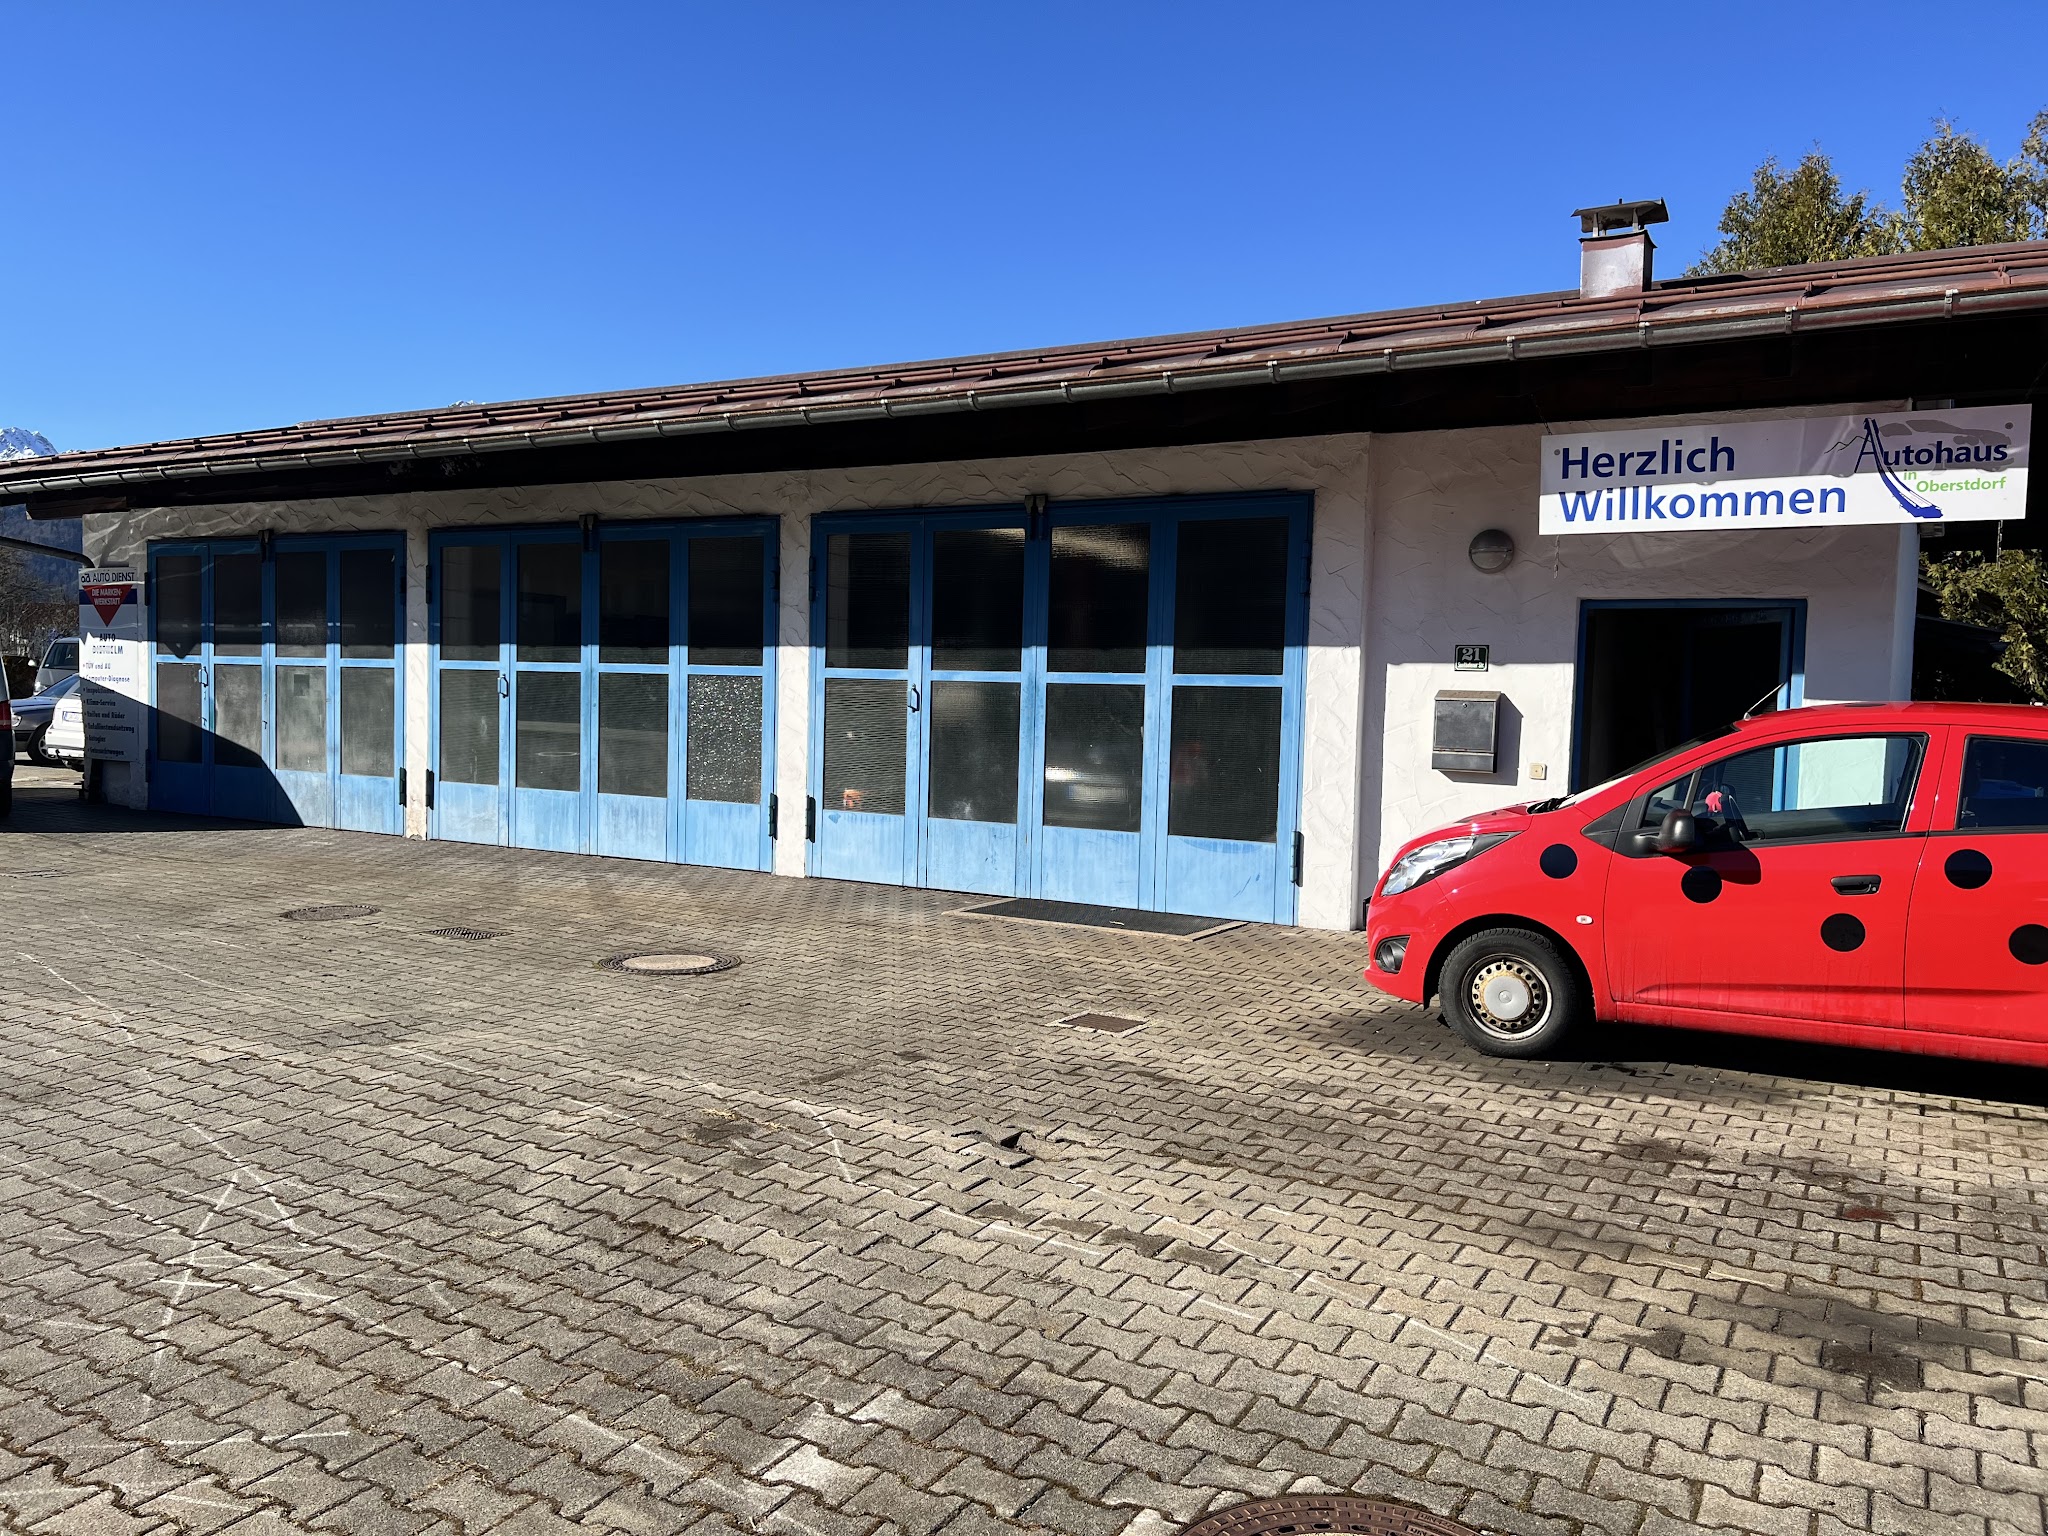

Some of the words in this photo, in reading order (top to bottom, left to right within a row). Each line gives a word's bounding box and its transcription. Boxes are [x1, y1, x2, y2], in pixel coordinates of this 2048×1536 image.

[1854, 417, 2008, 473] Autohaus
[1561, 436, 1735, 480] Herzlich
[1903, 469, 1917, 481] in
[1916, 476, 2007, 493] Oberstdorf
[1558, 484, 1846, 522] Willkommen
[93, 573, 110, 582] AUTO
[111, 572, 135, 582] DIENST
[94, 597, 120, 606] WERKSTATT
[99, 633, 116, 642] AUTO
[1461, 647, 1480, 661] 21
